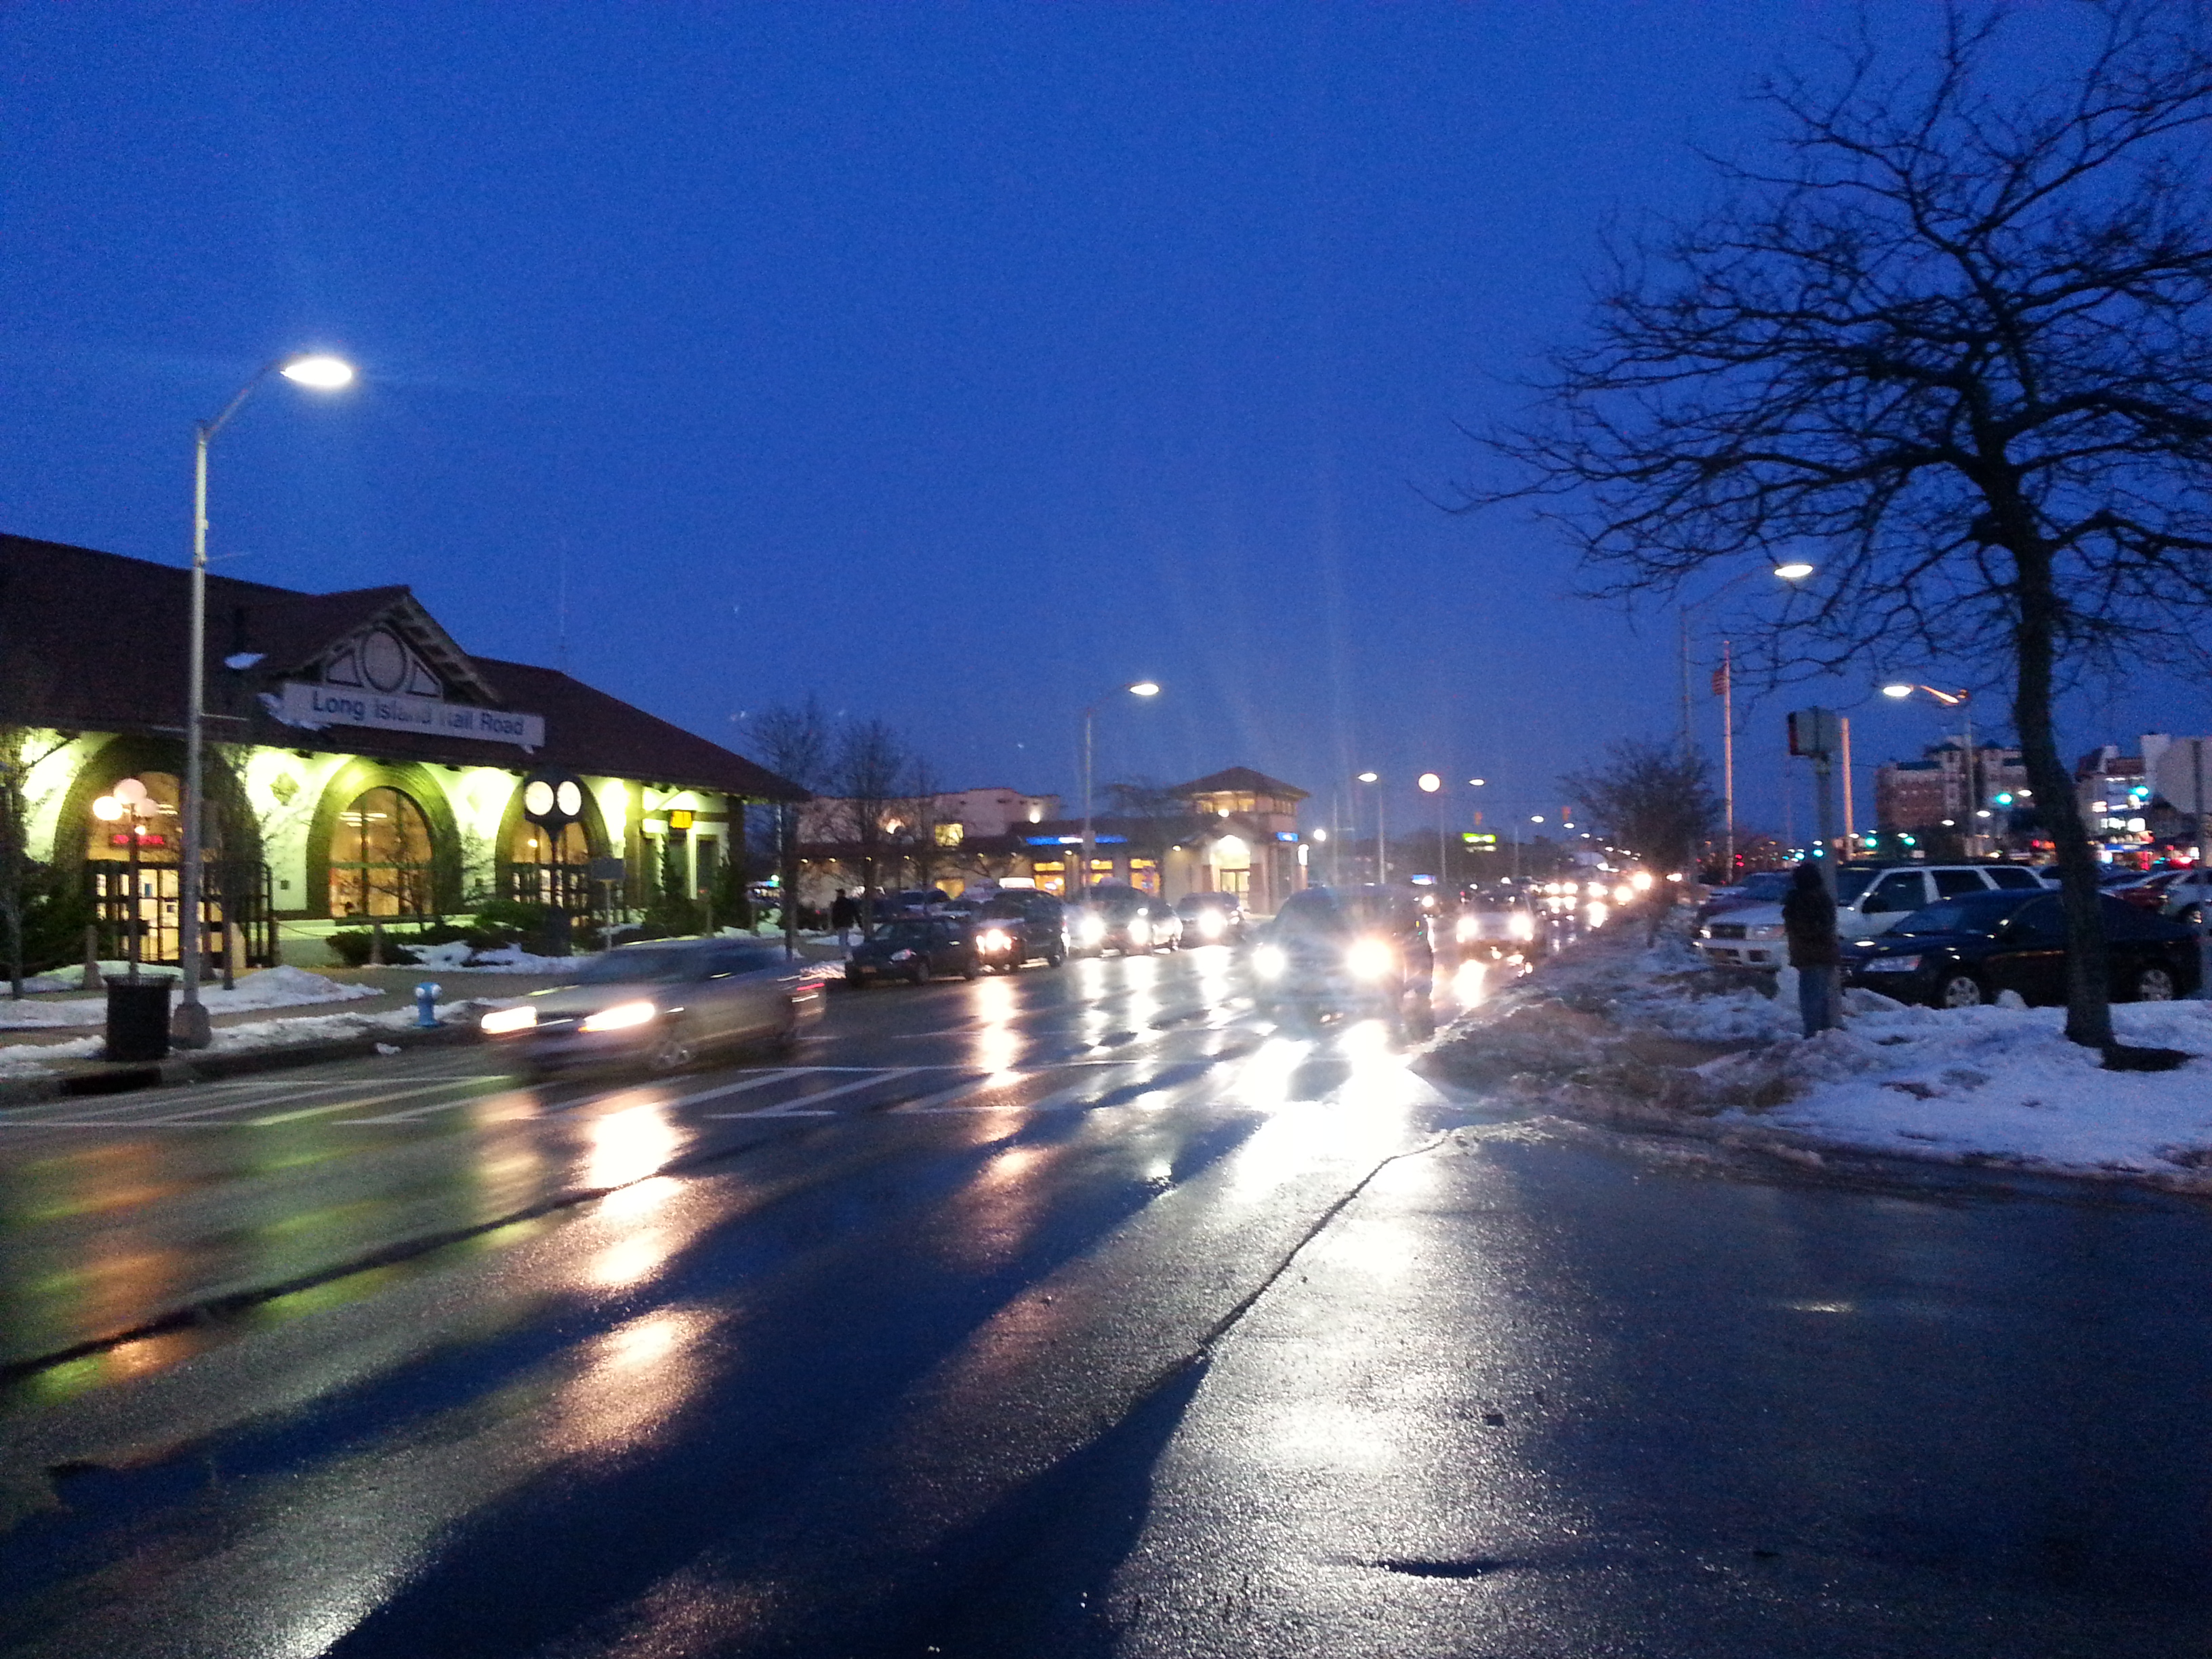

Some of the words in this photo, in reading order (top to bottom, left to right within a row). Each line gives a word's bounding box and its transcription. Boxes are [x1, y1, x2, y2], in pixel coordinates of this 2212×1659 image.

[312, 690, 365, 721] Long
[375, 697, 432, 724] Islad
[441, 709, 473, 730] ail
[480, 711, 523, 735] Road
